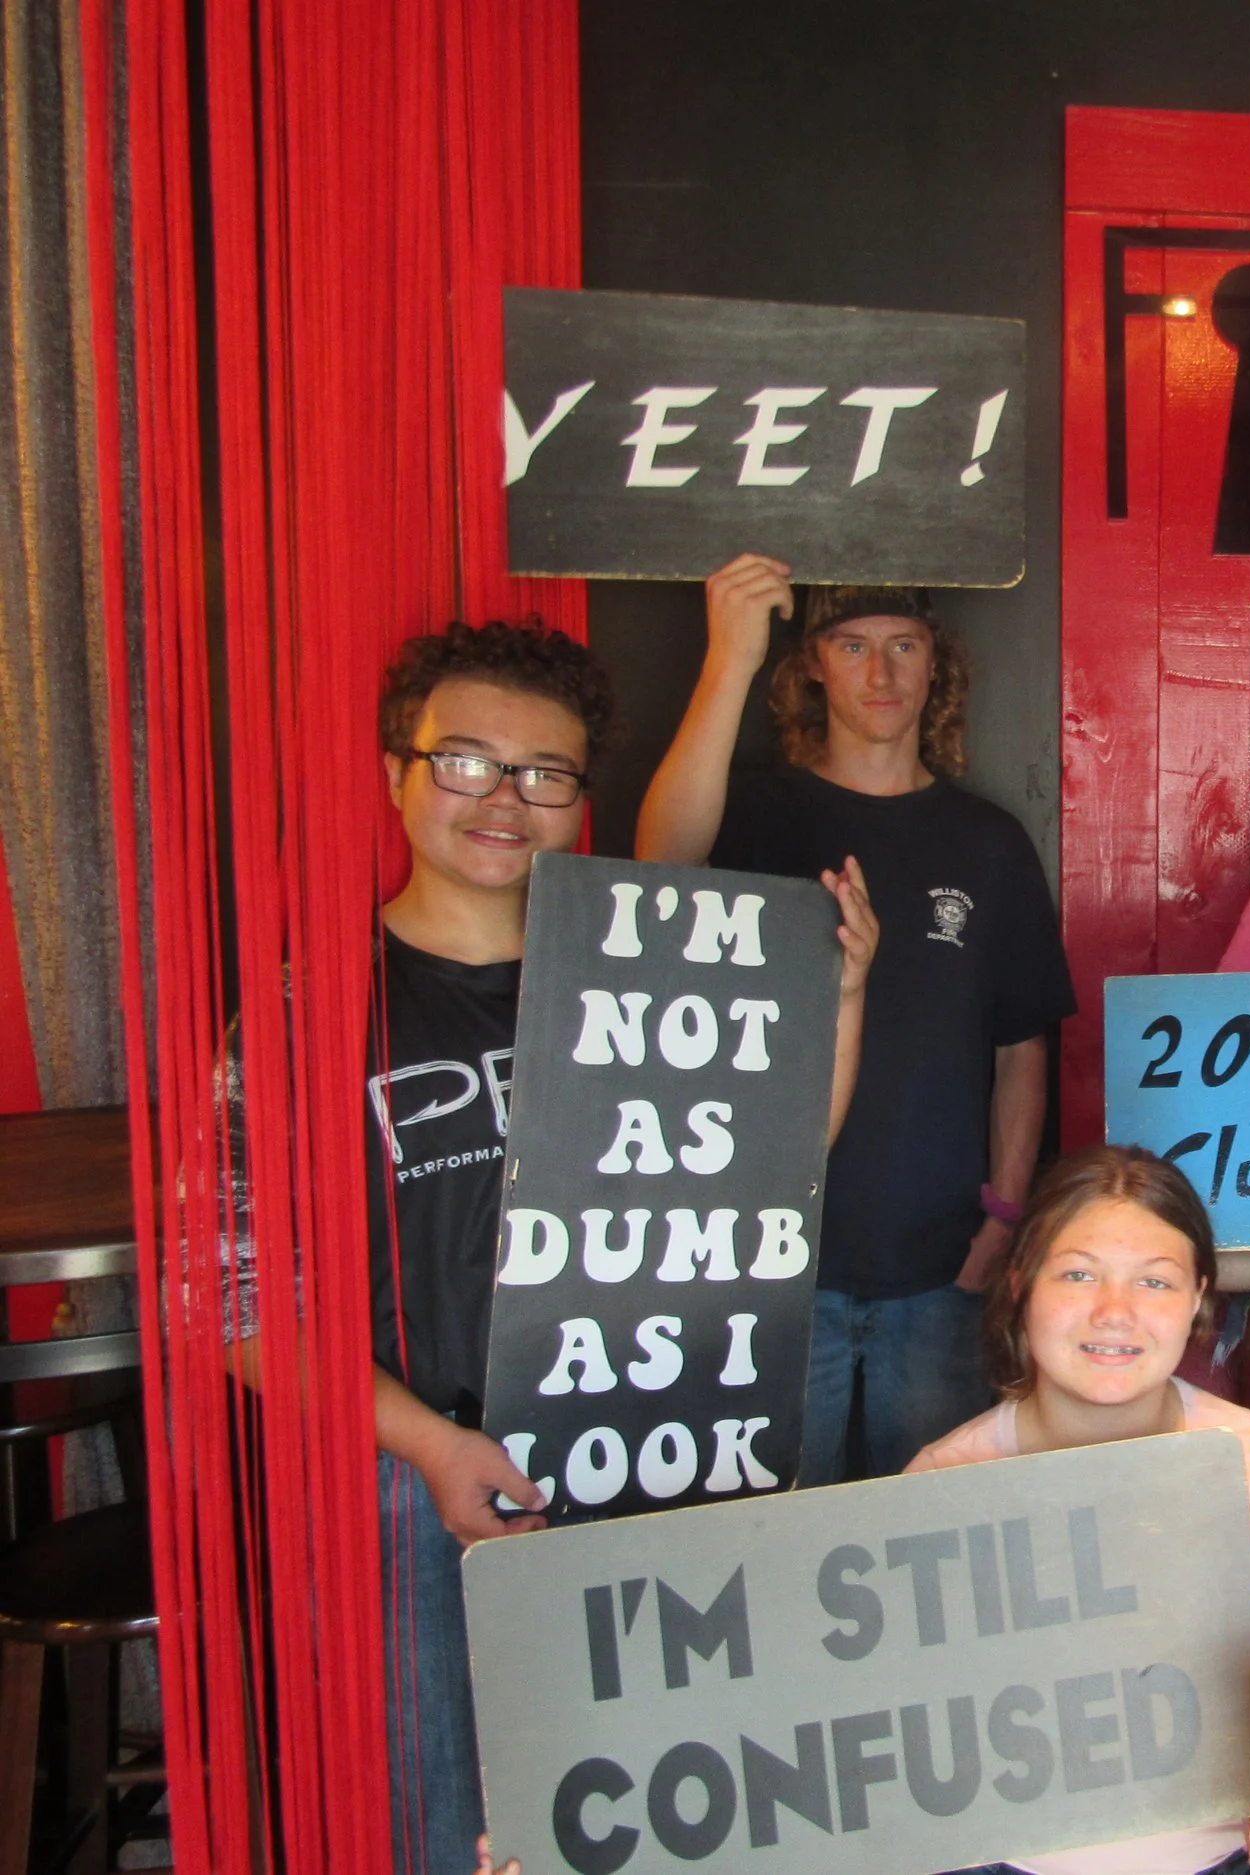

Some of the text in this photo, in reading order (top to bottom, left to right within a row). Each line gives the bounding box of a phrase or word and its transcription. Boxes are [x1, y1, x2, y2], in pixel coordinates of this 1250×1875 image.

[601, 882, 767, 967] I'M
[572, 989, 781, 1072] NOT
[597, 1099, 737, 1175] AS
[497, 1207, 811, 1287] DUMB
[538, 1312, 759, 1396] AS I
[497, 1415, 779, 1511] LOOK
[584, 1505, 1138, 1702] I'M STILL
[551, 1662, 1201, 1875] CONFUSED
